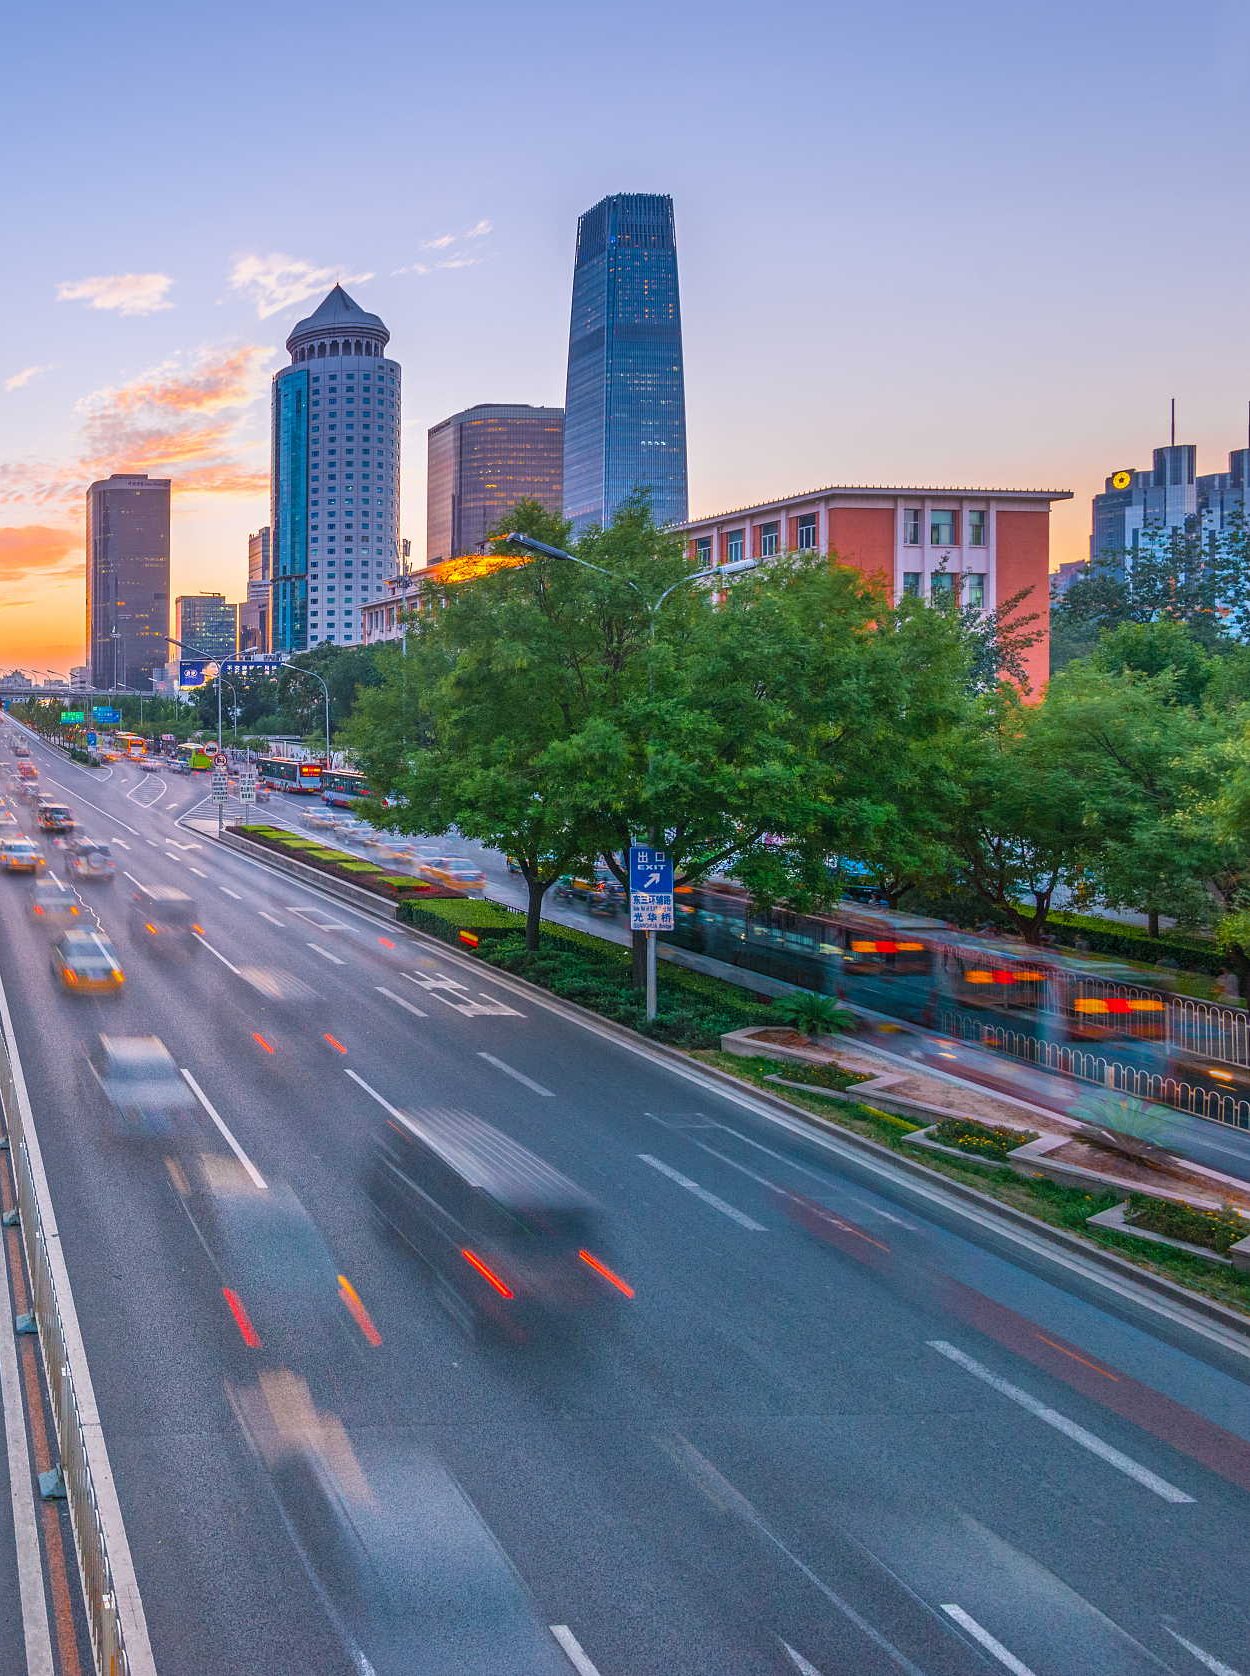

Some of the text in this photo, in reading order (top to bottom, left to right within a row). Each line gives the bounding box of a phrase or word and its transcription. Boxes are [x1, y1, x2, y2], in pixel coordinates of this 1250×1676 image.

[637, 851, 665, 863] 出口
[633, 895, 671, 905] 东三环辅路
[633, 912, 671, 922] 光华桥
